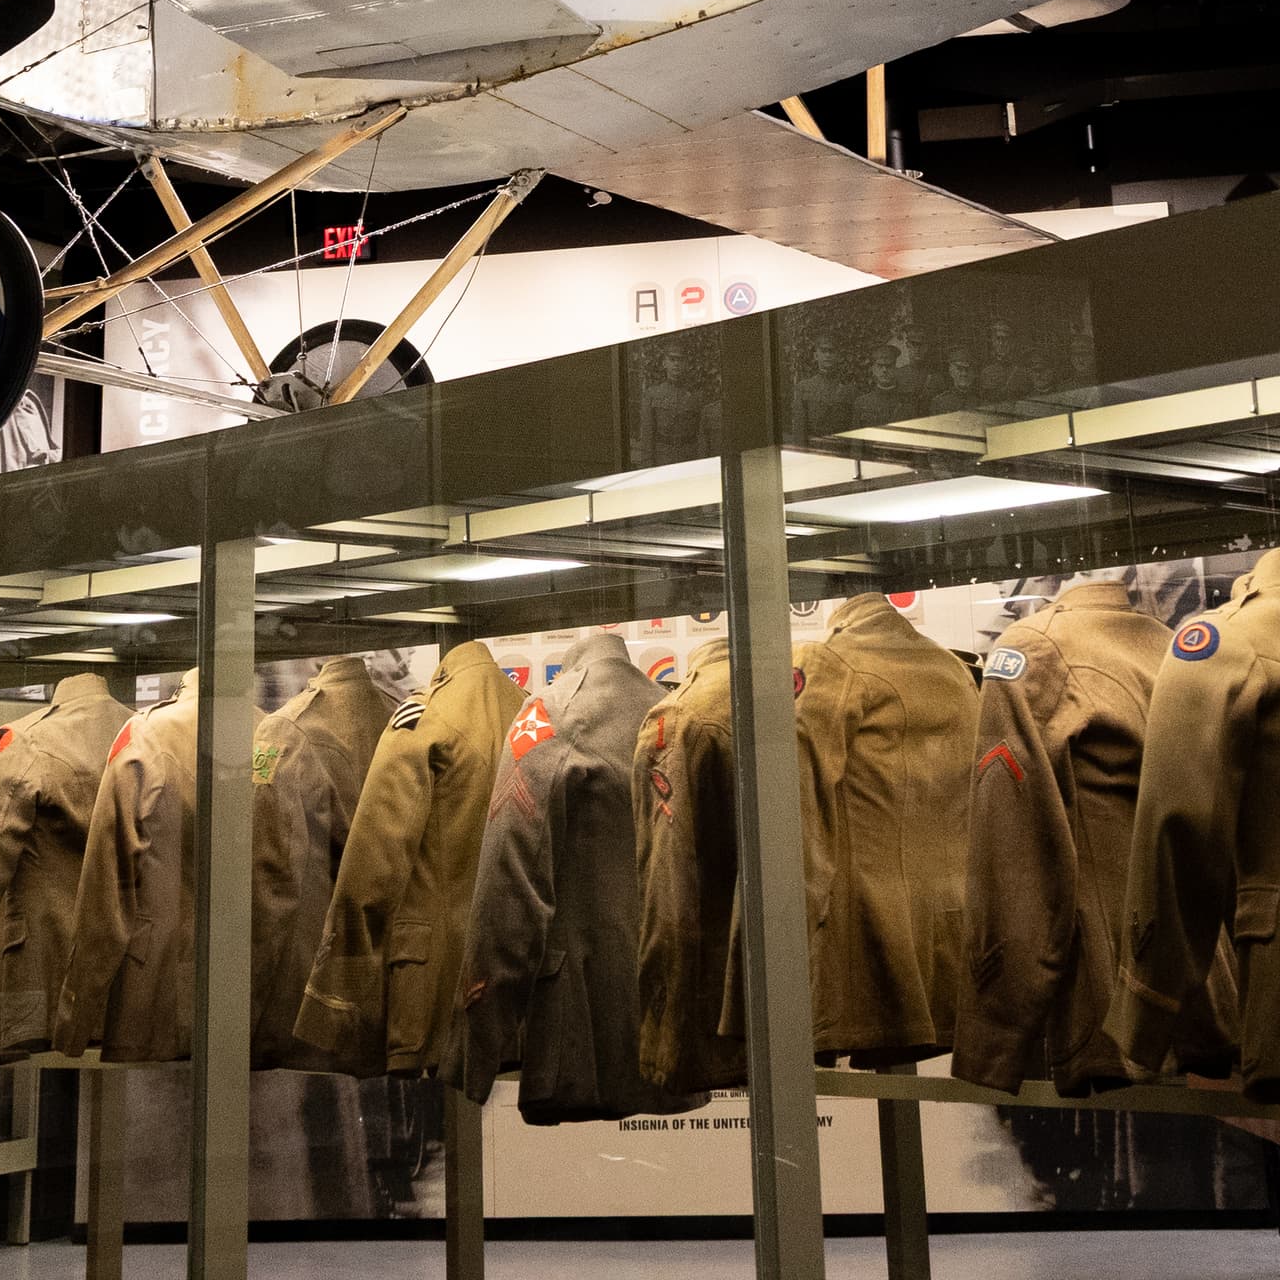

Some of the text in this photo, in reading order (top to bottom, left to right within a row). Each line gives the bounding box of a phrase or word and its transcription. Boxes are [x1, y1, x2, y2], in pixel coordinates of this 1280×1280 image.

[324, 226, 365, 259] EXIT
[139, 318, 170, 438] CRACY
[619, 1119, 668, 1131] INSIGNIA
[672, 1119, 687, 1131] OF
[690, 1118, 710, 1130] THE
[817, 1116, 833, 1128] MY
